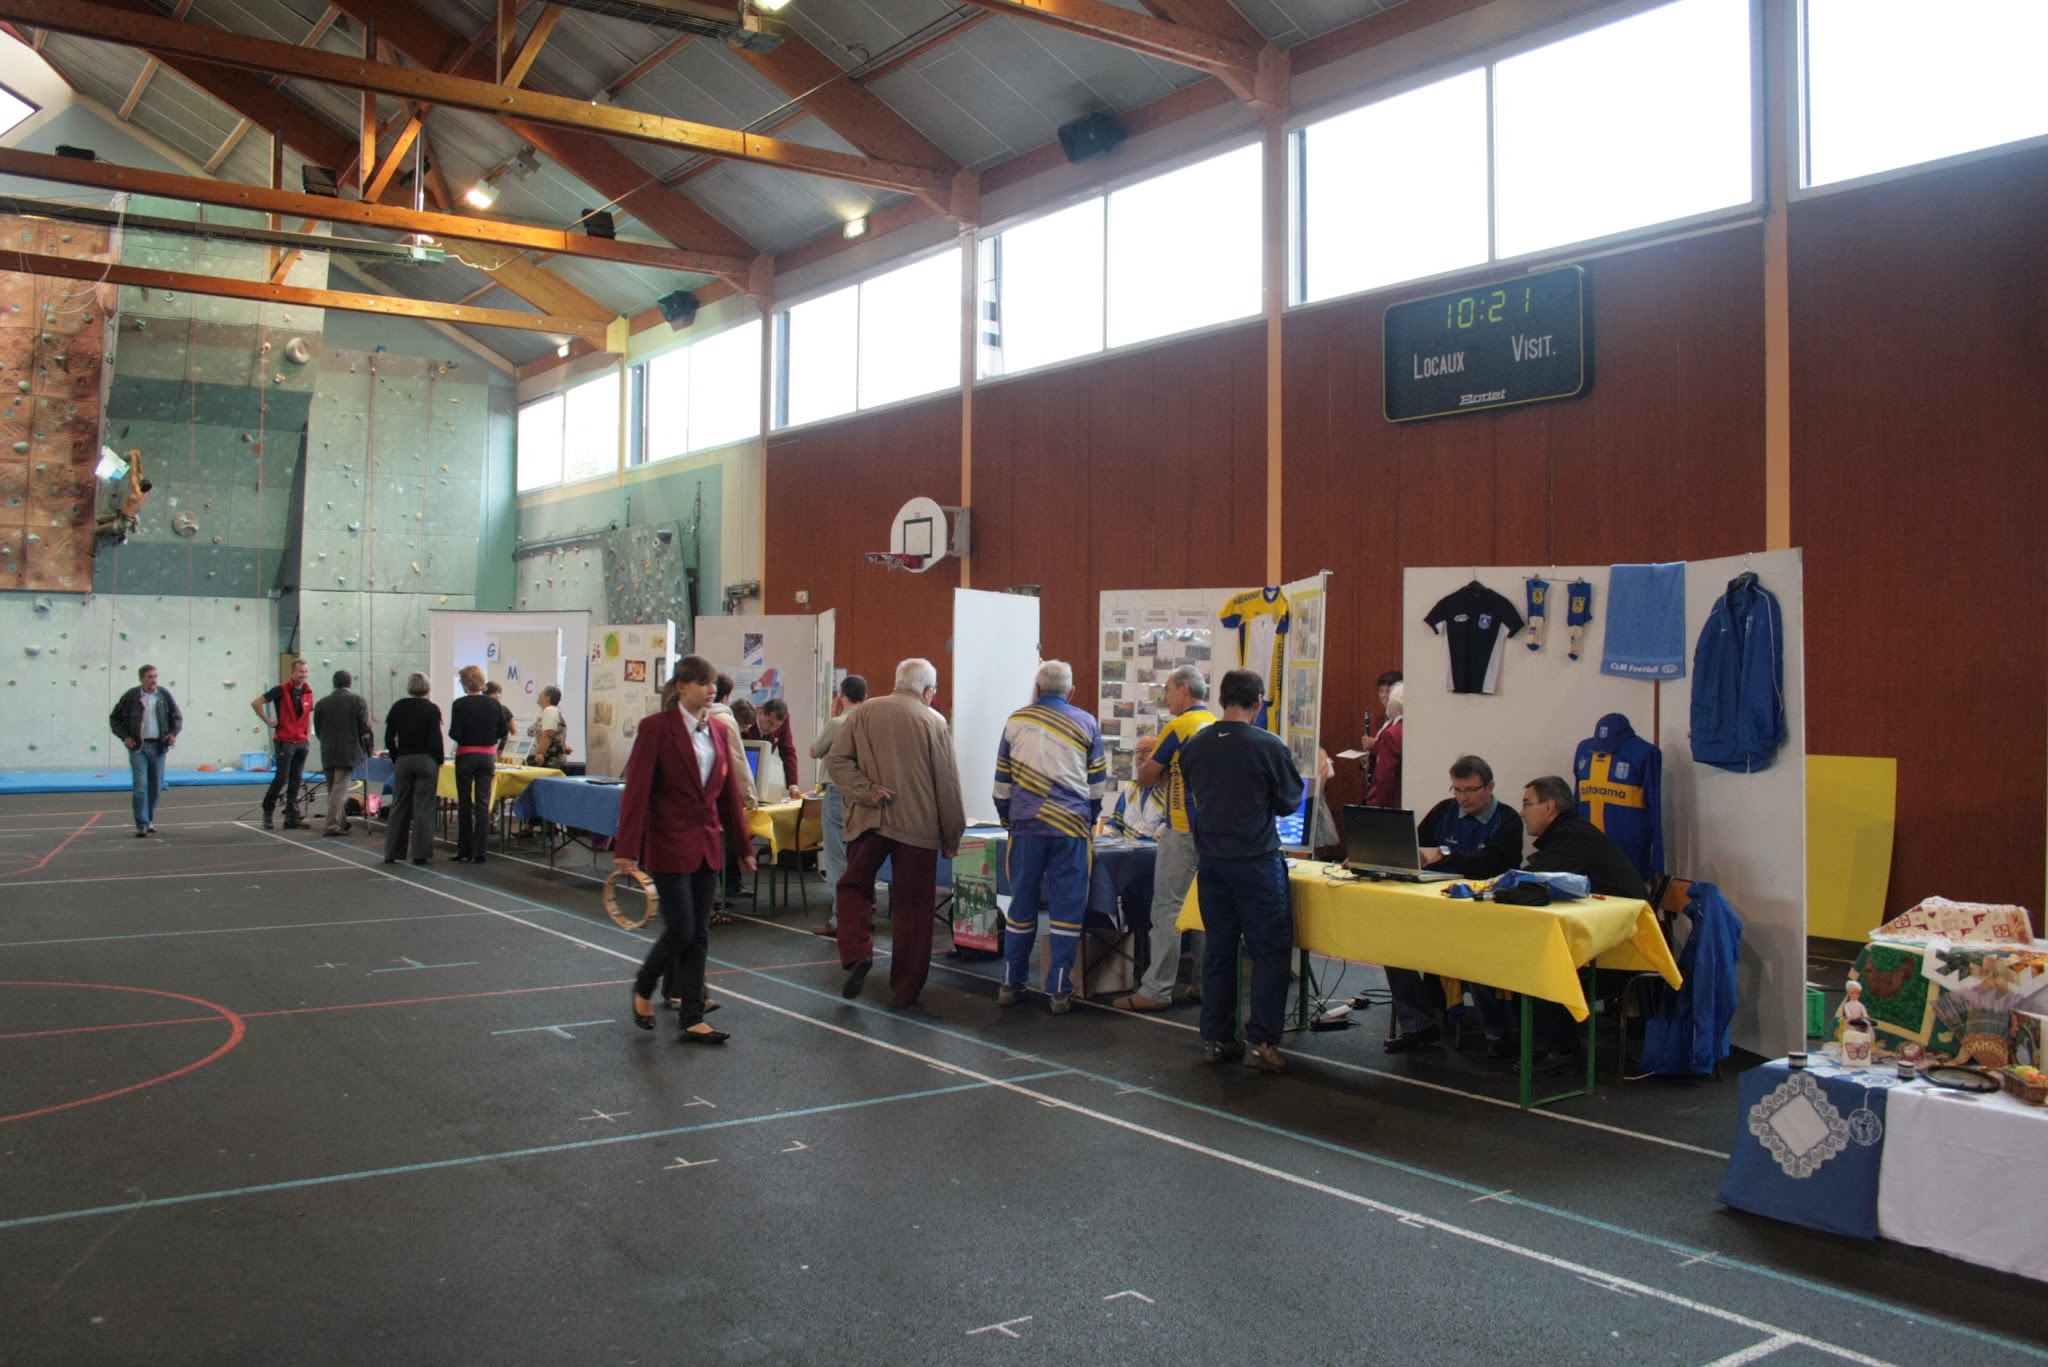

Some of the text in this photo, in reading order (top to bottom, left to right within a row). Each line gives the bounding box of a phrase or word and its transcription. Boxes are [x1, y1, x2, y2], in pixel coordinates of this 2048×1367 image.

[1447, 288, 1531, 328] 10:21
[1459, 388, 1506, 406] Bodet
[487, 643, 533, 694] G M C
[1610, 662, 1628, 671] CLM
[1580, 784, 1626, 799] astorama
